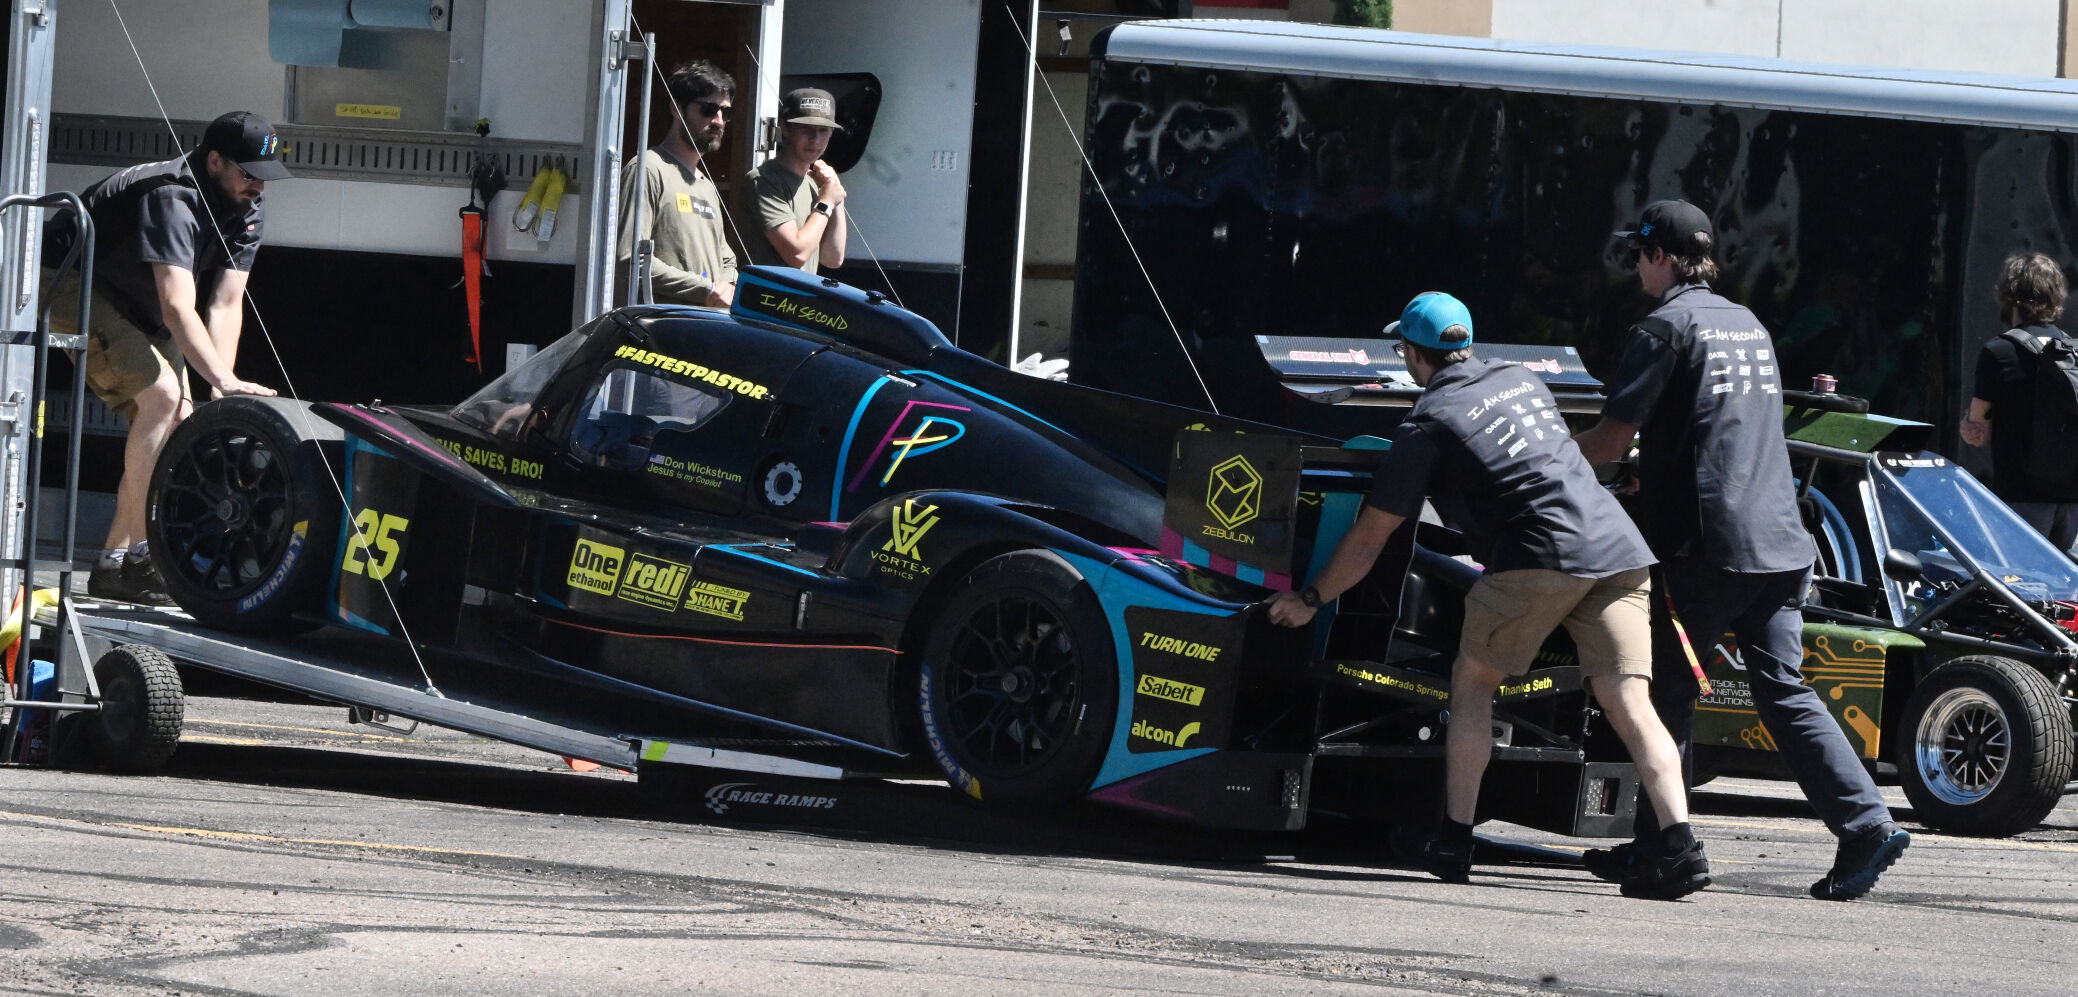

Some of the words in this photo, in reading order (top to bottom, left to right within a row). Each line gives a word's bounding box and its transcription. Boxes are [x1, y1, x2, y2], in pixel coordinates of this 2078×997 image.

[760, 293, 776, 306] I
[777, 298, 797, 315] AM
[798, 306, 848, 330] SECOND
[1699, 329, 1716, 339] I
[1716, 328, 1730, 340] AM
[1729, 328, 1766, 341] SECOND
[1290, 352, 1332, 361] GENERAL
[1331, 353, 1353, 362] TIRE
[614, 345, 769, 400] #FASTESTPASTOR
[1467, 406, 1485, 420] I
[1483, 396, 1501, 411] AM
[1498, 381, 1535, 401] SECOND
[464, 446, 508, 475] SAVES,
[511, 458, 545, 480] BRO!
[647, 462, 675, 477] Jesus
[676, 471, 683, 479] is
[684, 474, 695, 483] my
[695, 475, 722, 488] Copilot
[664, 456, 685, 470] Don
[687, 461, 742, 483] Wickstrum
[342, 507, 409, 581] 25
[1202, 525, 1255, 544] ZEBULON
[574, 543, 619, 576] One
[871, 550, 931, 575] VORTEX
[242, 550, 296, 610] MICHELIN
[569, 572, 614, 592] ethanol
[623, 560, 688, 597] redi
[880, 566, 914, 580] OPTICS
[688, 588, 732, 612] SHANE
[1140, 631, 1188, 655] TURN
[1184, 642, 1222, 662] ONE
[1141, 676, 1194, 702] Sabelt
[1337, 663, 1374, 681] Porsche
[1375, 673, 1415, 691] Colorado
[1416, 684, 1449, 700] Springs
[1499, 682, 1531, 697] Thanks
[1532, 677, 1553, 691] Seth
[1699, 695, 1754, 706] SOLUTIONS
[920, 673, 956, 774] MICHELIN
[1131, 719, 1174, 745] alcon
[727, 790, 773, 804] RACE
[773, 794, 838, 809] RAMPS
